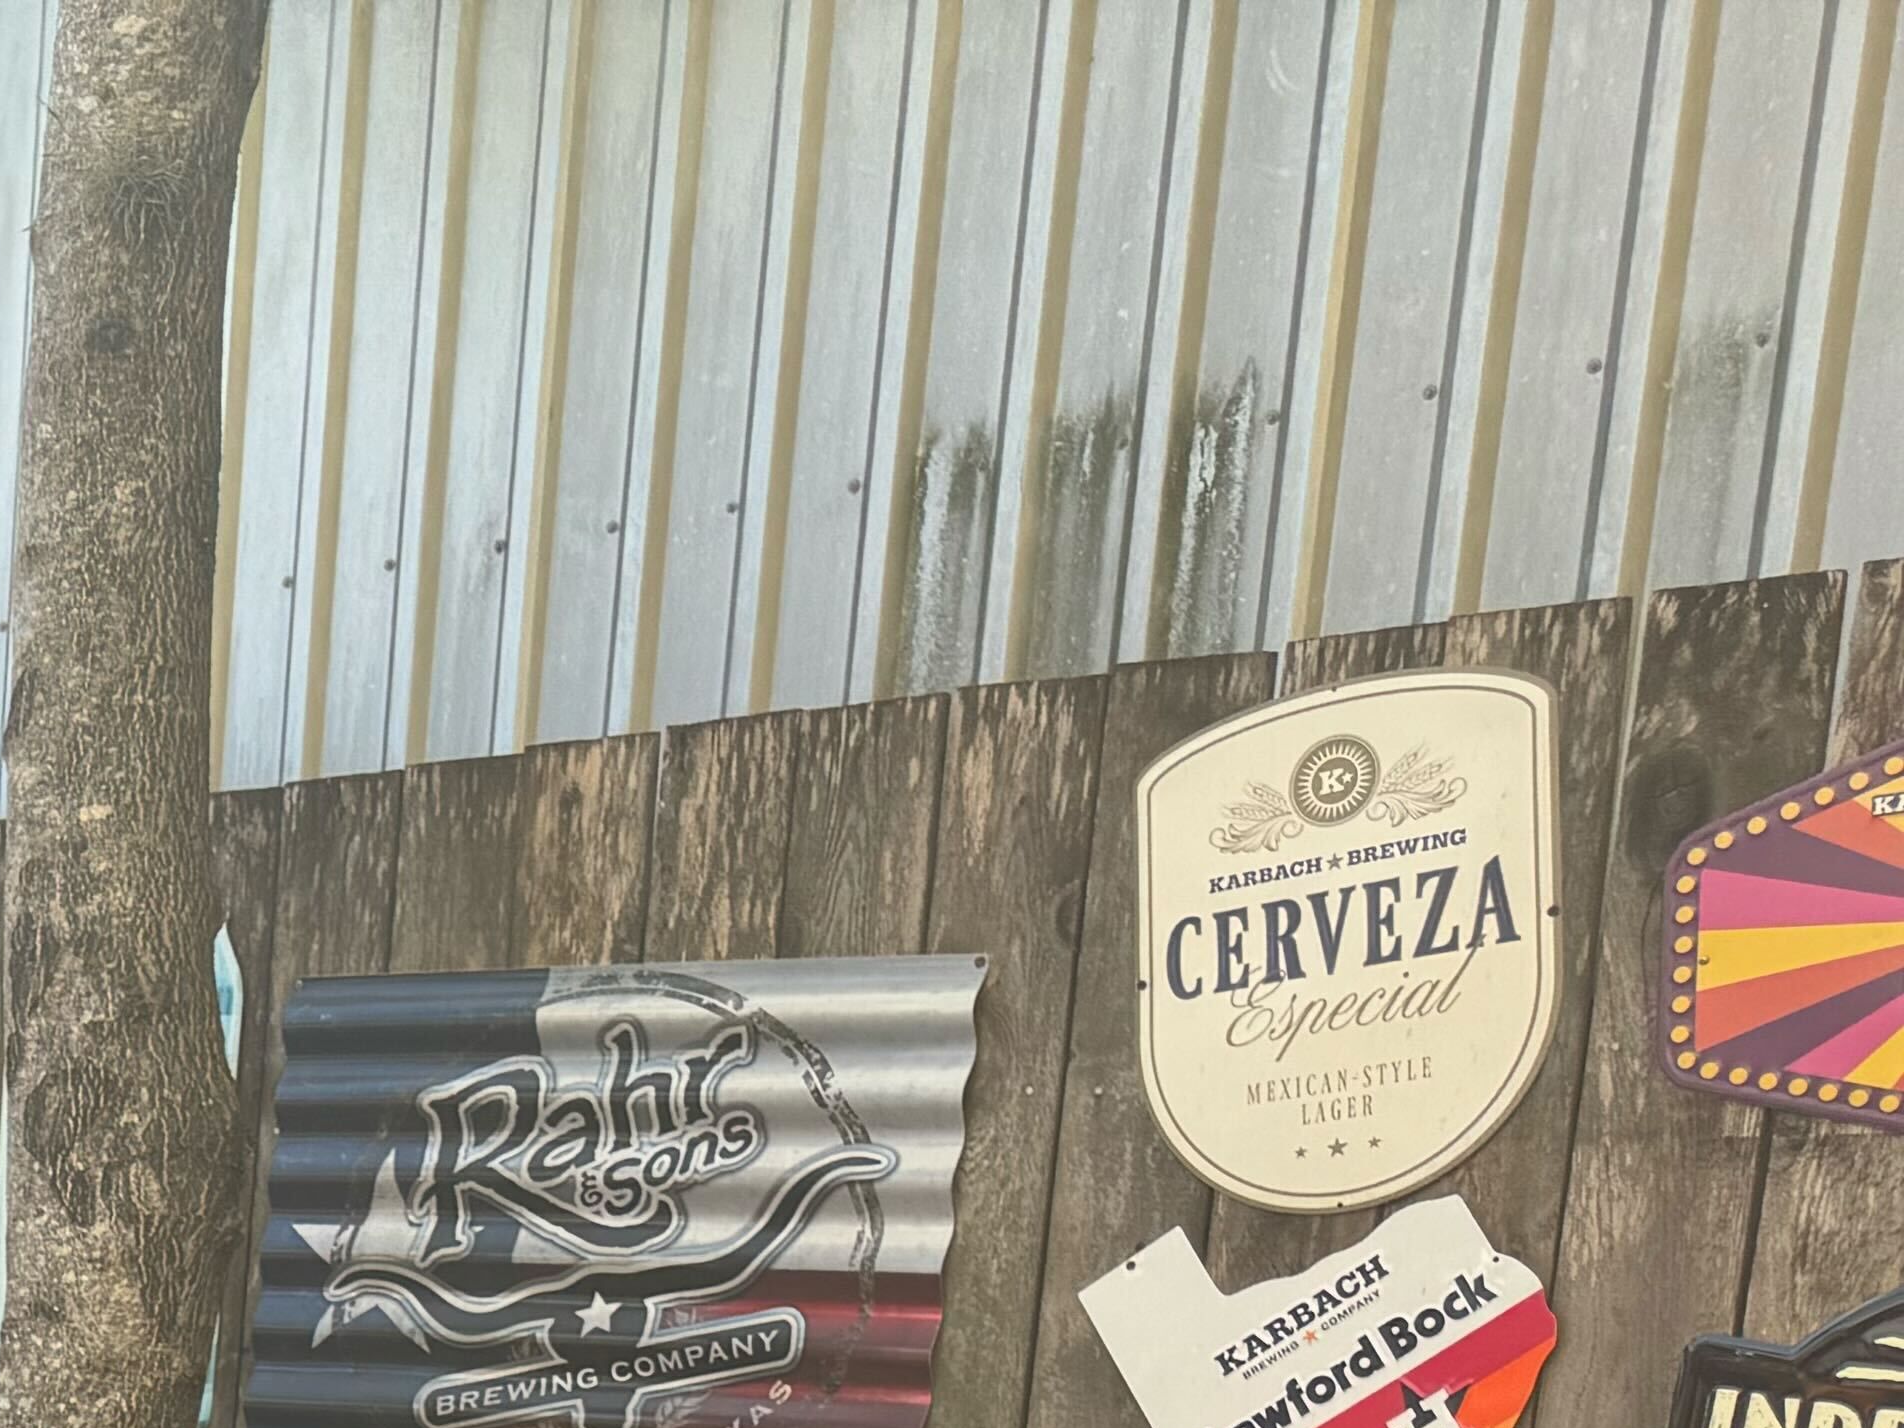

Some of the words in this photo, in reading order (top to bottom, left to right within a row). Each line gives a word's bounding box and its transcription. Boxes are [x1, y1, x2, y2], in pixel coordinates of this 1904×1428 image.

[1209, 857, 1323, 894] KARBACH
[1347, 828, 1468, 867] BREWING
[1165, 855, 1522, 1002] CERVEZA
[1225, 935, 1485, 1063] Especial
[1247, 1056, 1434, 1106] MEXICAN-STYLE
[1302, 1094, 1375, 1127] LAGER
[414, 1017, 758, 1268] Rahr
[1212, 1254, 1390, 1378] KARBACH
[1240, 1339, 1300, 1382] BREWING
[1320, 1288, 1383, 1332] COMPANY
[1379, 1268, 1499, 1362] Bock
[434, 1368, 600, 1419] BREWING
[610, 1330, 782, 1384] COMPANY
